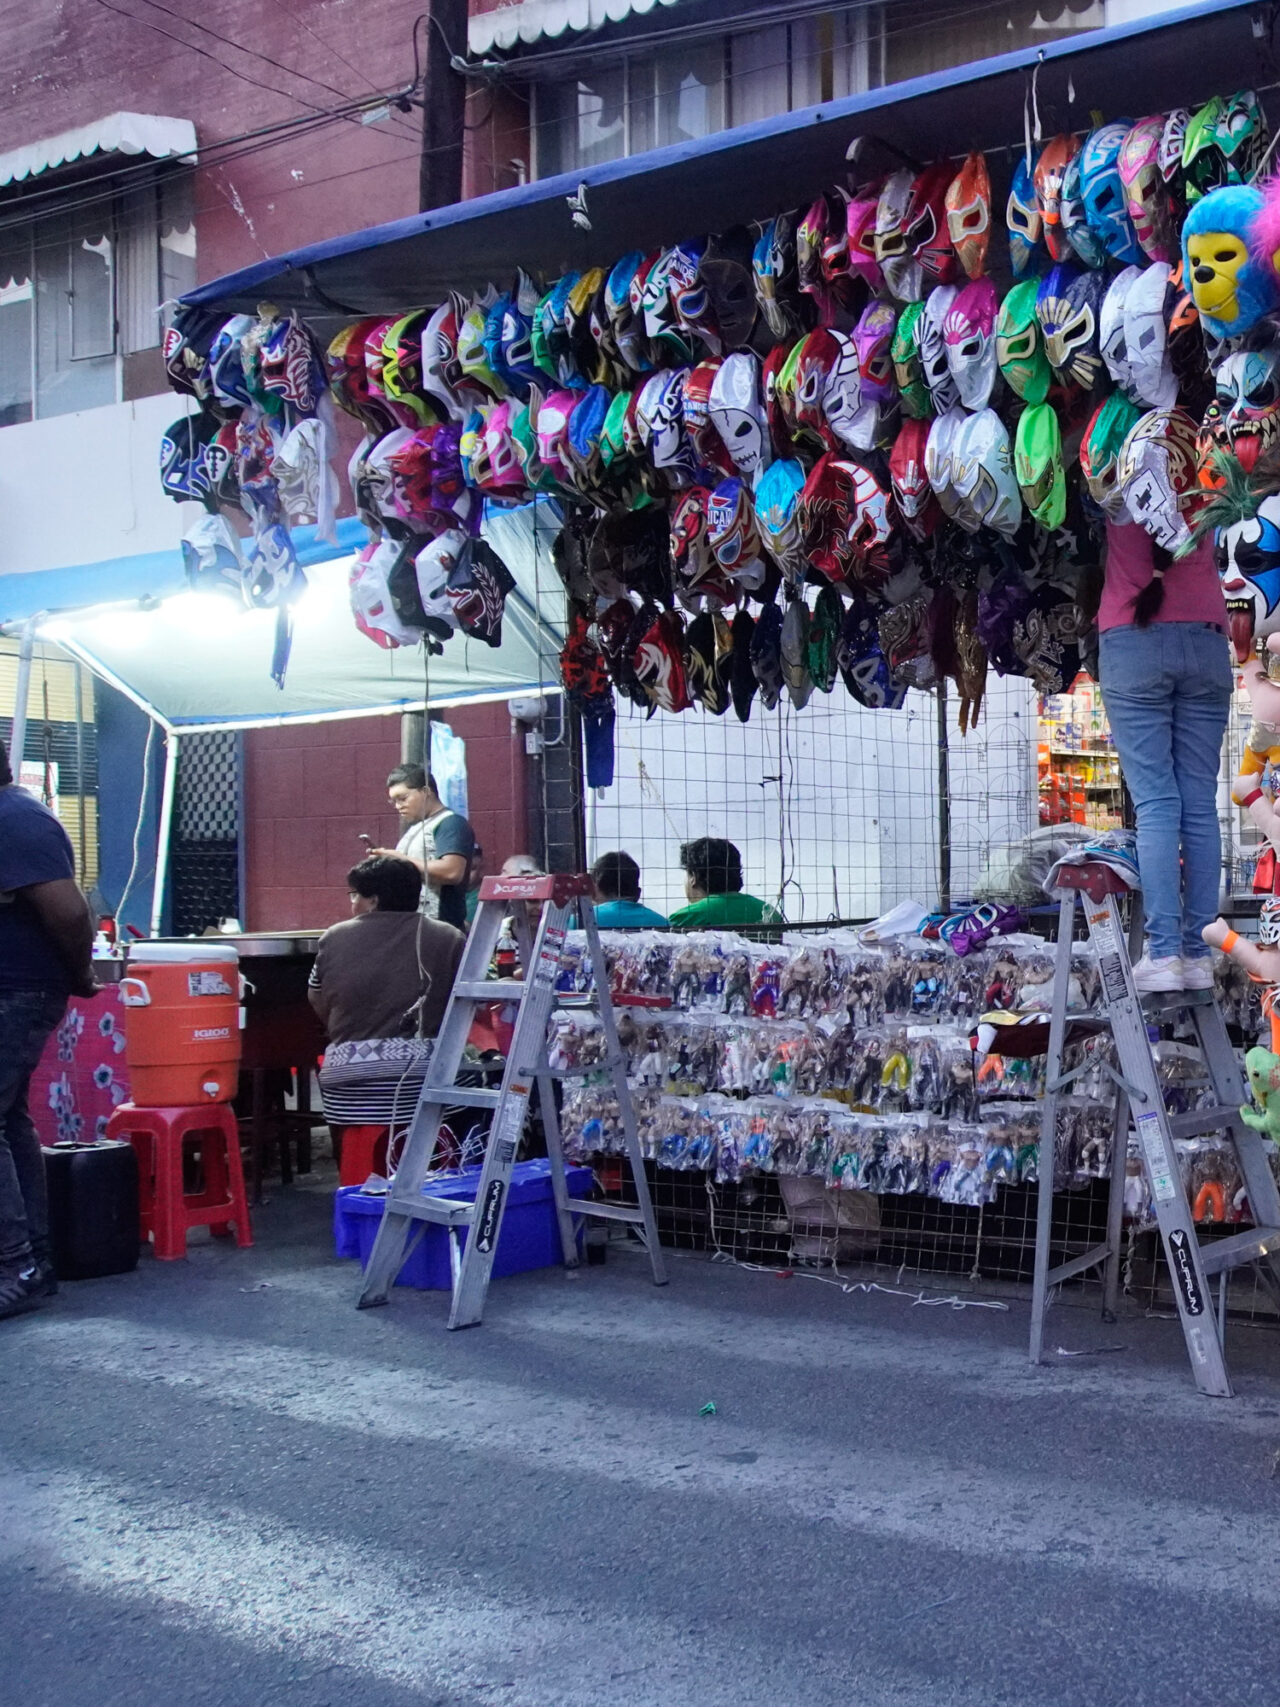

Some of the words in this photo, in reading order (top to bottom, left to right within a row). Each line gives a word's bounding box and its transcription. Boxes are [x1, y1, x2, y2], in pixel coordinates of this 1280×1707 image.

[194, 1028, 229, 1038] IGLOO
[484, 1181, 501, 1237] CUPRUM
[1177, 1248, 1199, 1314] CUPRUM
